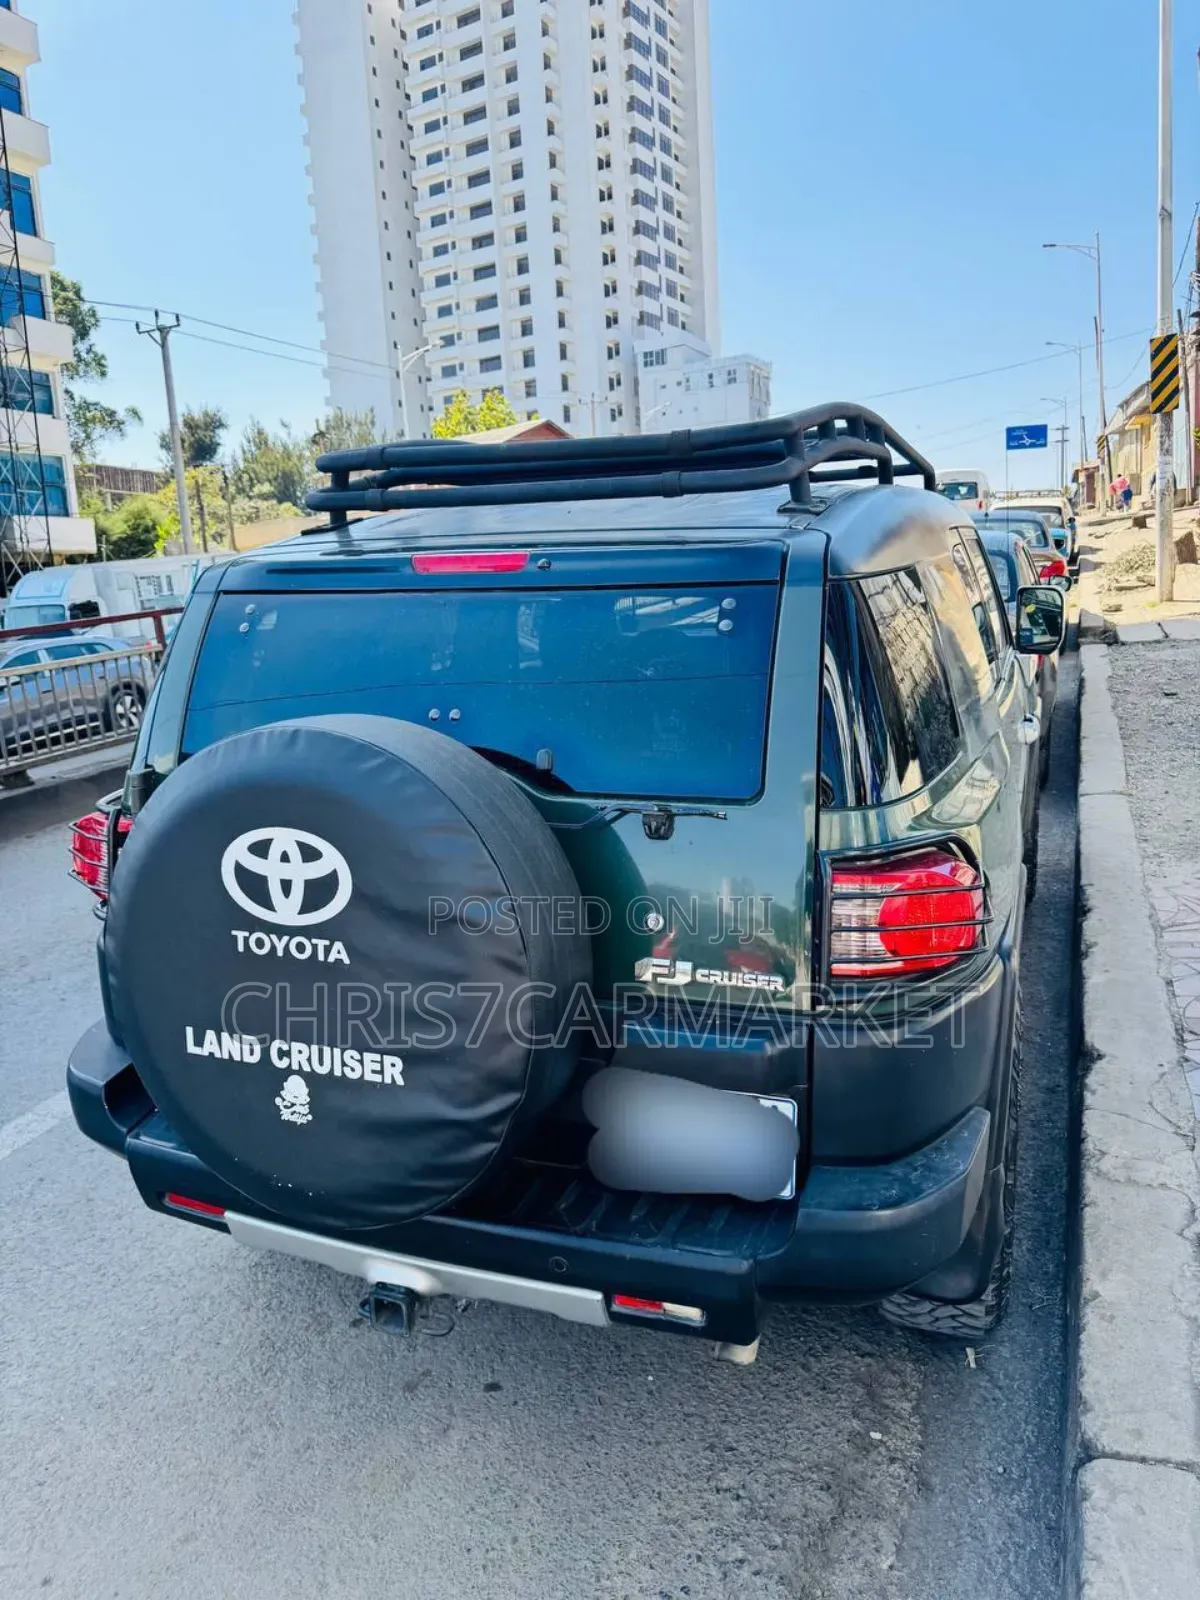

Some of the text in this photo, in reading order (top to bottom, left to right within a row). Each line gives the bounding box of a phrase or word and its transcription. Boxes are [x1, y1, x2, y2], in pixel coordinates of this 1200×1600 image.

[231, 930, 350, 965] TOYOTA
[634, 957, 785, 992] FJ CRUISER
[185, 1026, 405, 1086] LAND CRUISER
